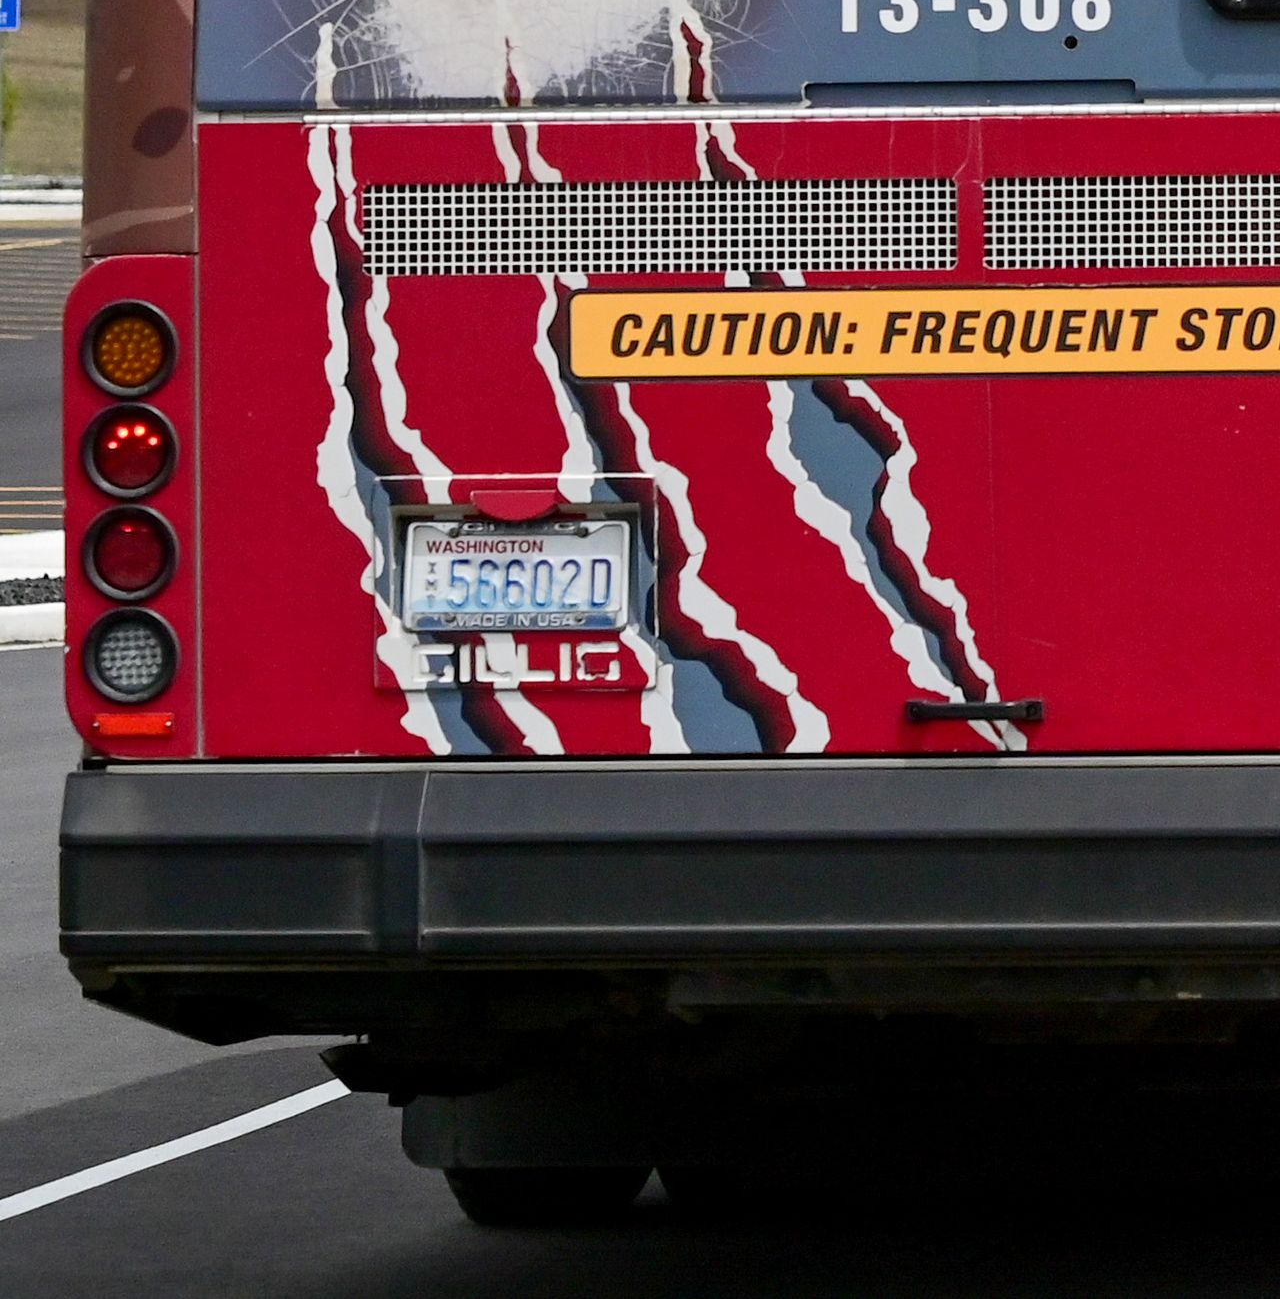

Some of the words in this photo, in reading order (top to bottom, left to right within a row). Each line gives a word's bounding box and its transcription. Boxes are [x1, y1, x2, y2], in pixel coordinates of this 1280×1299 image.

[611, 311, 858, 357] CAUTION:
[881, 309, 1160, 357] FREQUENT
[426, 539, 544, 554] WASHINGTON
[452, 613, 507, 627] MADE
[512, 613, 531, 627] IN
[537, 613, 575, 627] USA
[412, 642, 621, 683] GILLIG
